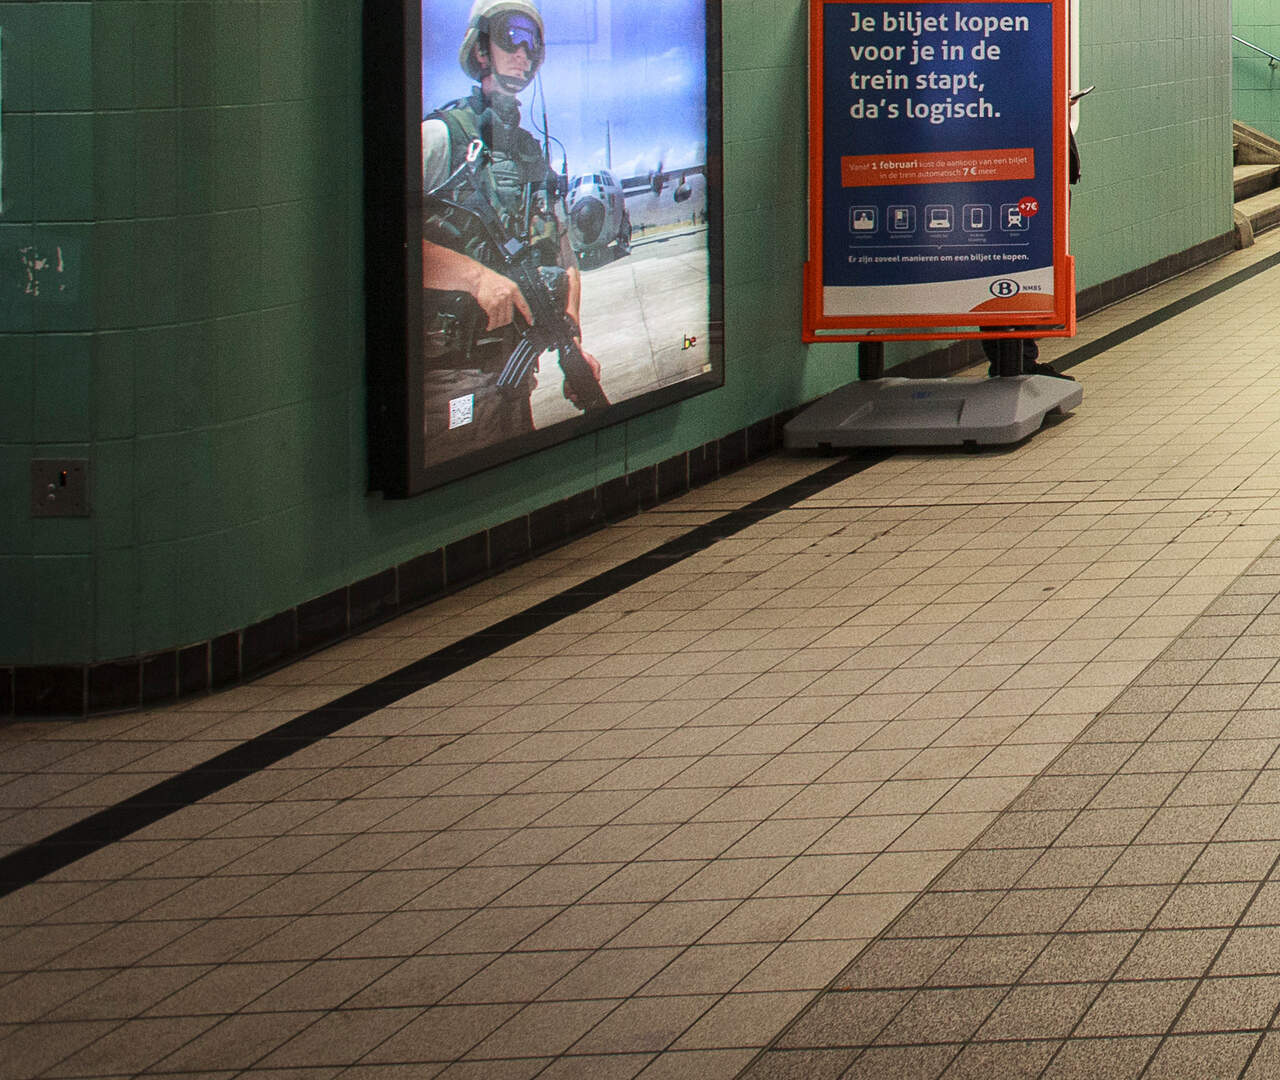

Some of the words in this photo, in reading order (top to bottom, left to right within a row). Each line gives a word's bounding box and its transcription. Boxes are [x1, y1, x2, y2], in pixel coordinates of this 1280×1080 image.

[850, 12, 876, 32] Je
[883, 12, 948, 36] biljet
[955, 12, 1029, 37] kopen
[850, 45, 905, 61] voor
[910, 41, 935, 65] je
[941, 40, 964, 60] in
[971, 40, 1000, 60] de
[850, 70, 909, 90] trein
[916, 71, 984, 95] stapt,
[906, 98, 1001, 124] logisch.
[871, 162, 877, 170] 1
[879, 160, 918, 170] februari
[946, 159, 977, 169] aankoop
[1008, 156, 1028, 165] biljet
[963, 168, 969, 176] 7
[970, 167, 977, 176] €
[1020, 201, 1037, 211] +7€
[858, 255, 873, 264] zijn
[875, 255, 900, 263] zoveel
[902, 254, 939, 262] manieren
[970, 253, 992, 262] biljet
[1002, 253, 1029, 263] kopen.
